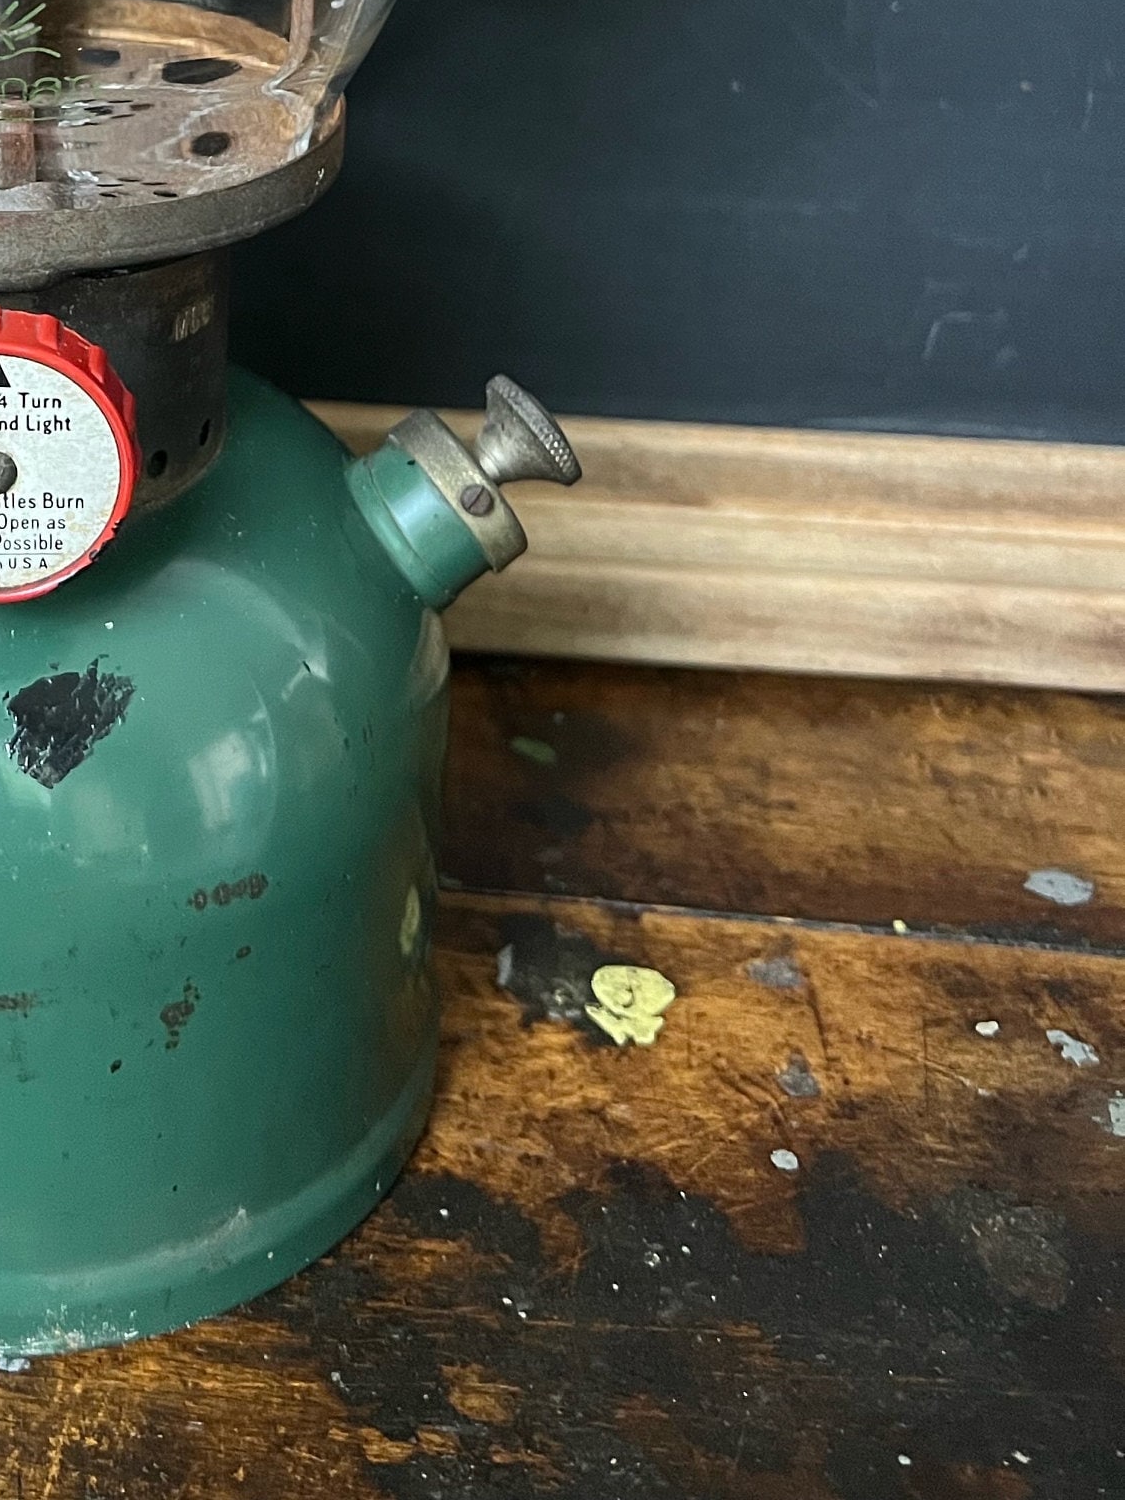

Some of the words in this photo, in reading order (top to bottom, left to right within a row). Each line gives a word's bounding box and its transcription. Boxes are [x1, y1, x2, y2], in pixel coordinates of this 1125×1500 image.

[18, 392, 62, 409] Turn
[26, 415, 72, 435] Light
[42, 493, 85, 510] Burn
[46, 517, 66, 530] as
